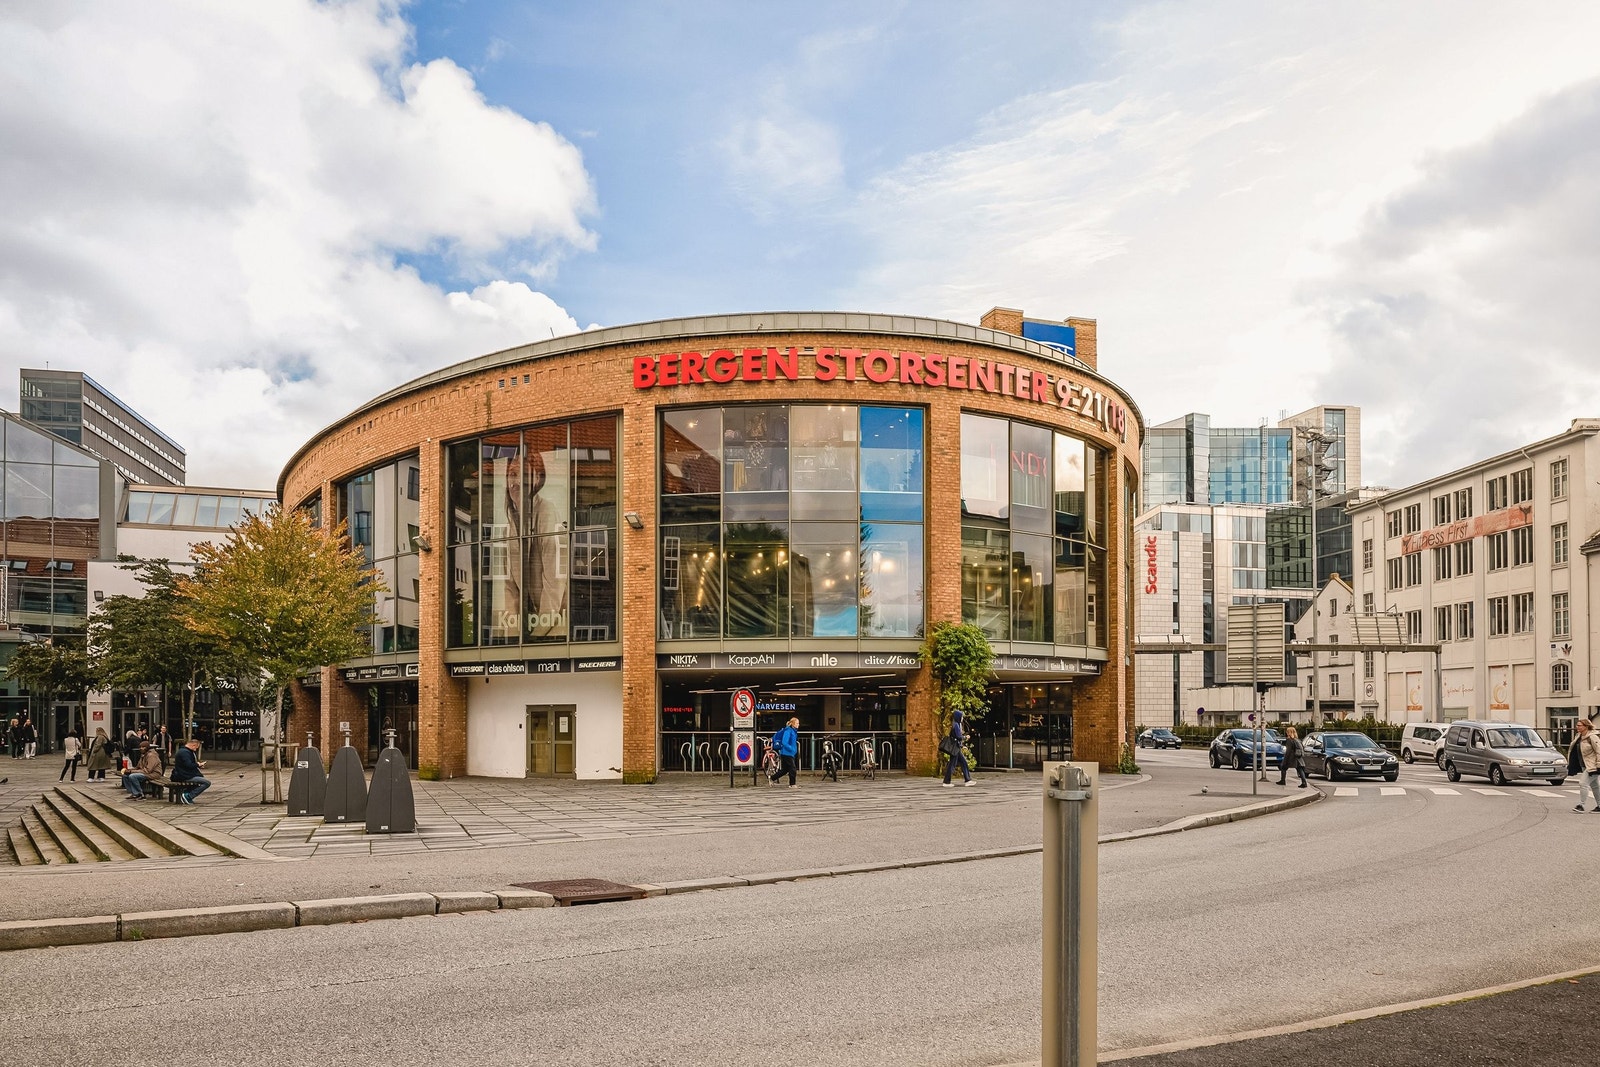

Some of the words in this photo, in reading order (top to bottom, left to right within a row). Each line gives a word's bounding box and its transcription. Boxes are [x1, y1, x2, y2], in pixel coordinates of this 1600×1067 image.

[633, 346, 798, 389] BERGEN
[815, 347, 1049, 403] STORSENTER
[1448, 522, 1468, 541] First
[1144, 536, 1157, 594] Scandic
[498, 609, 567, 632] Kapahl
[578, 661, 617, 669] SKECHERS
[670, 655, 698, 664] NIKITA
[728, 654, 775, 666] KappAhl
[811, 654, 838, 667] nille
[1014, 657, 1039, 669] KICKS
[489, 664, 502, 673] clas
[503, 663, 525, 673] ohlson
[538, 661, 560, 672] mani
[218, 709, 234, 717] Cut
[235, 709, 257, 717] time.
